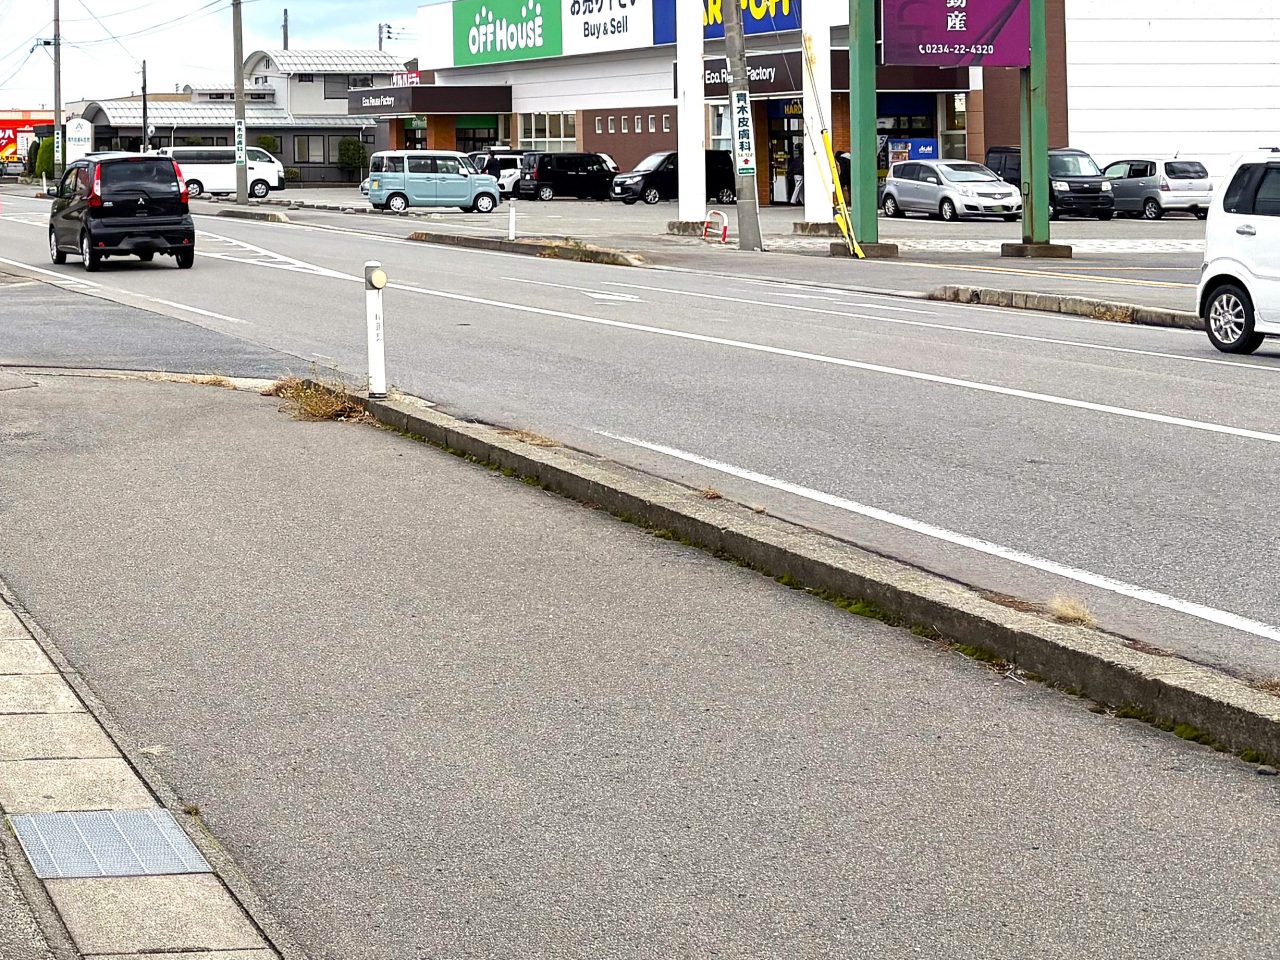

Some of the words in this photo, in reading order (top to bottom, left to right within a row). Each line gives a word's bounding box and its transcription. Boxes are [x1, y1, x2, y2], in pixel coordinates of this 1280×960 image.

[583, 21, 601, 40] Buy
[603, 23, 609, 36] &
[610, 16, 628, 35] Sell
[925, 43, 994, 55] 0234-22-4320
[746, 66, 776, 83] Factory
[736, 92, 751, 152] 青木皮膚科
